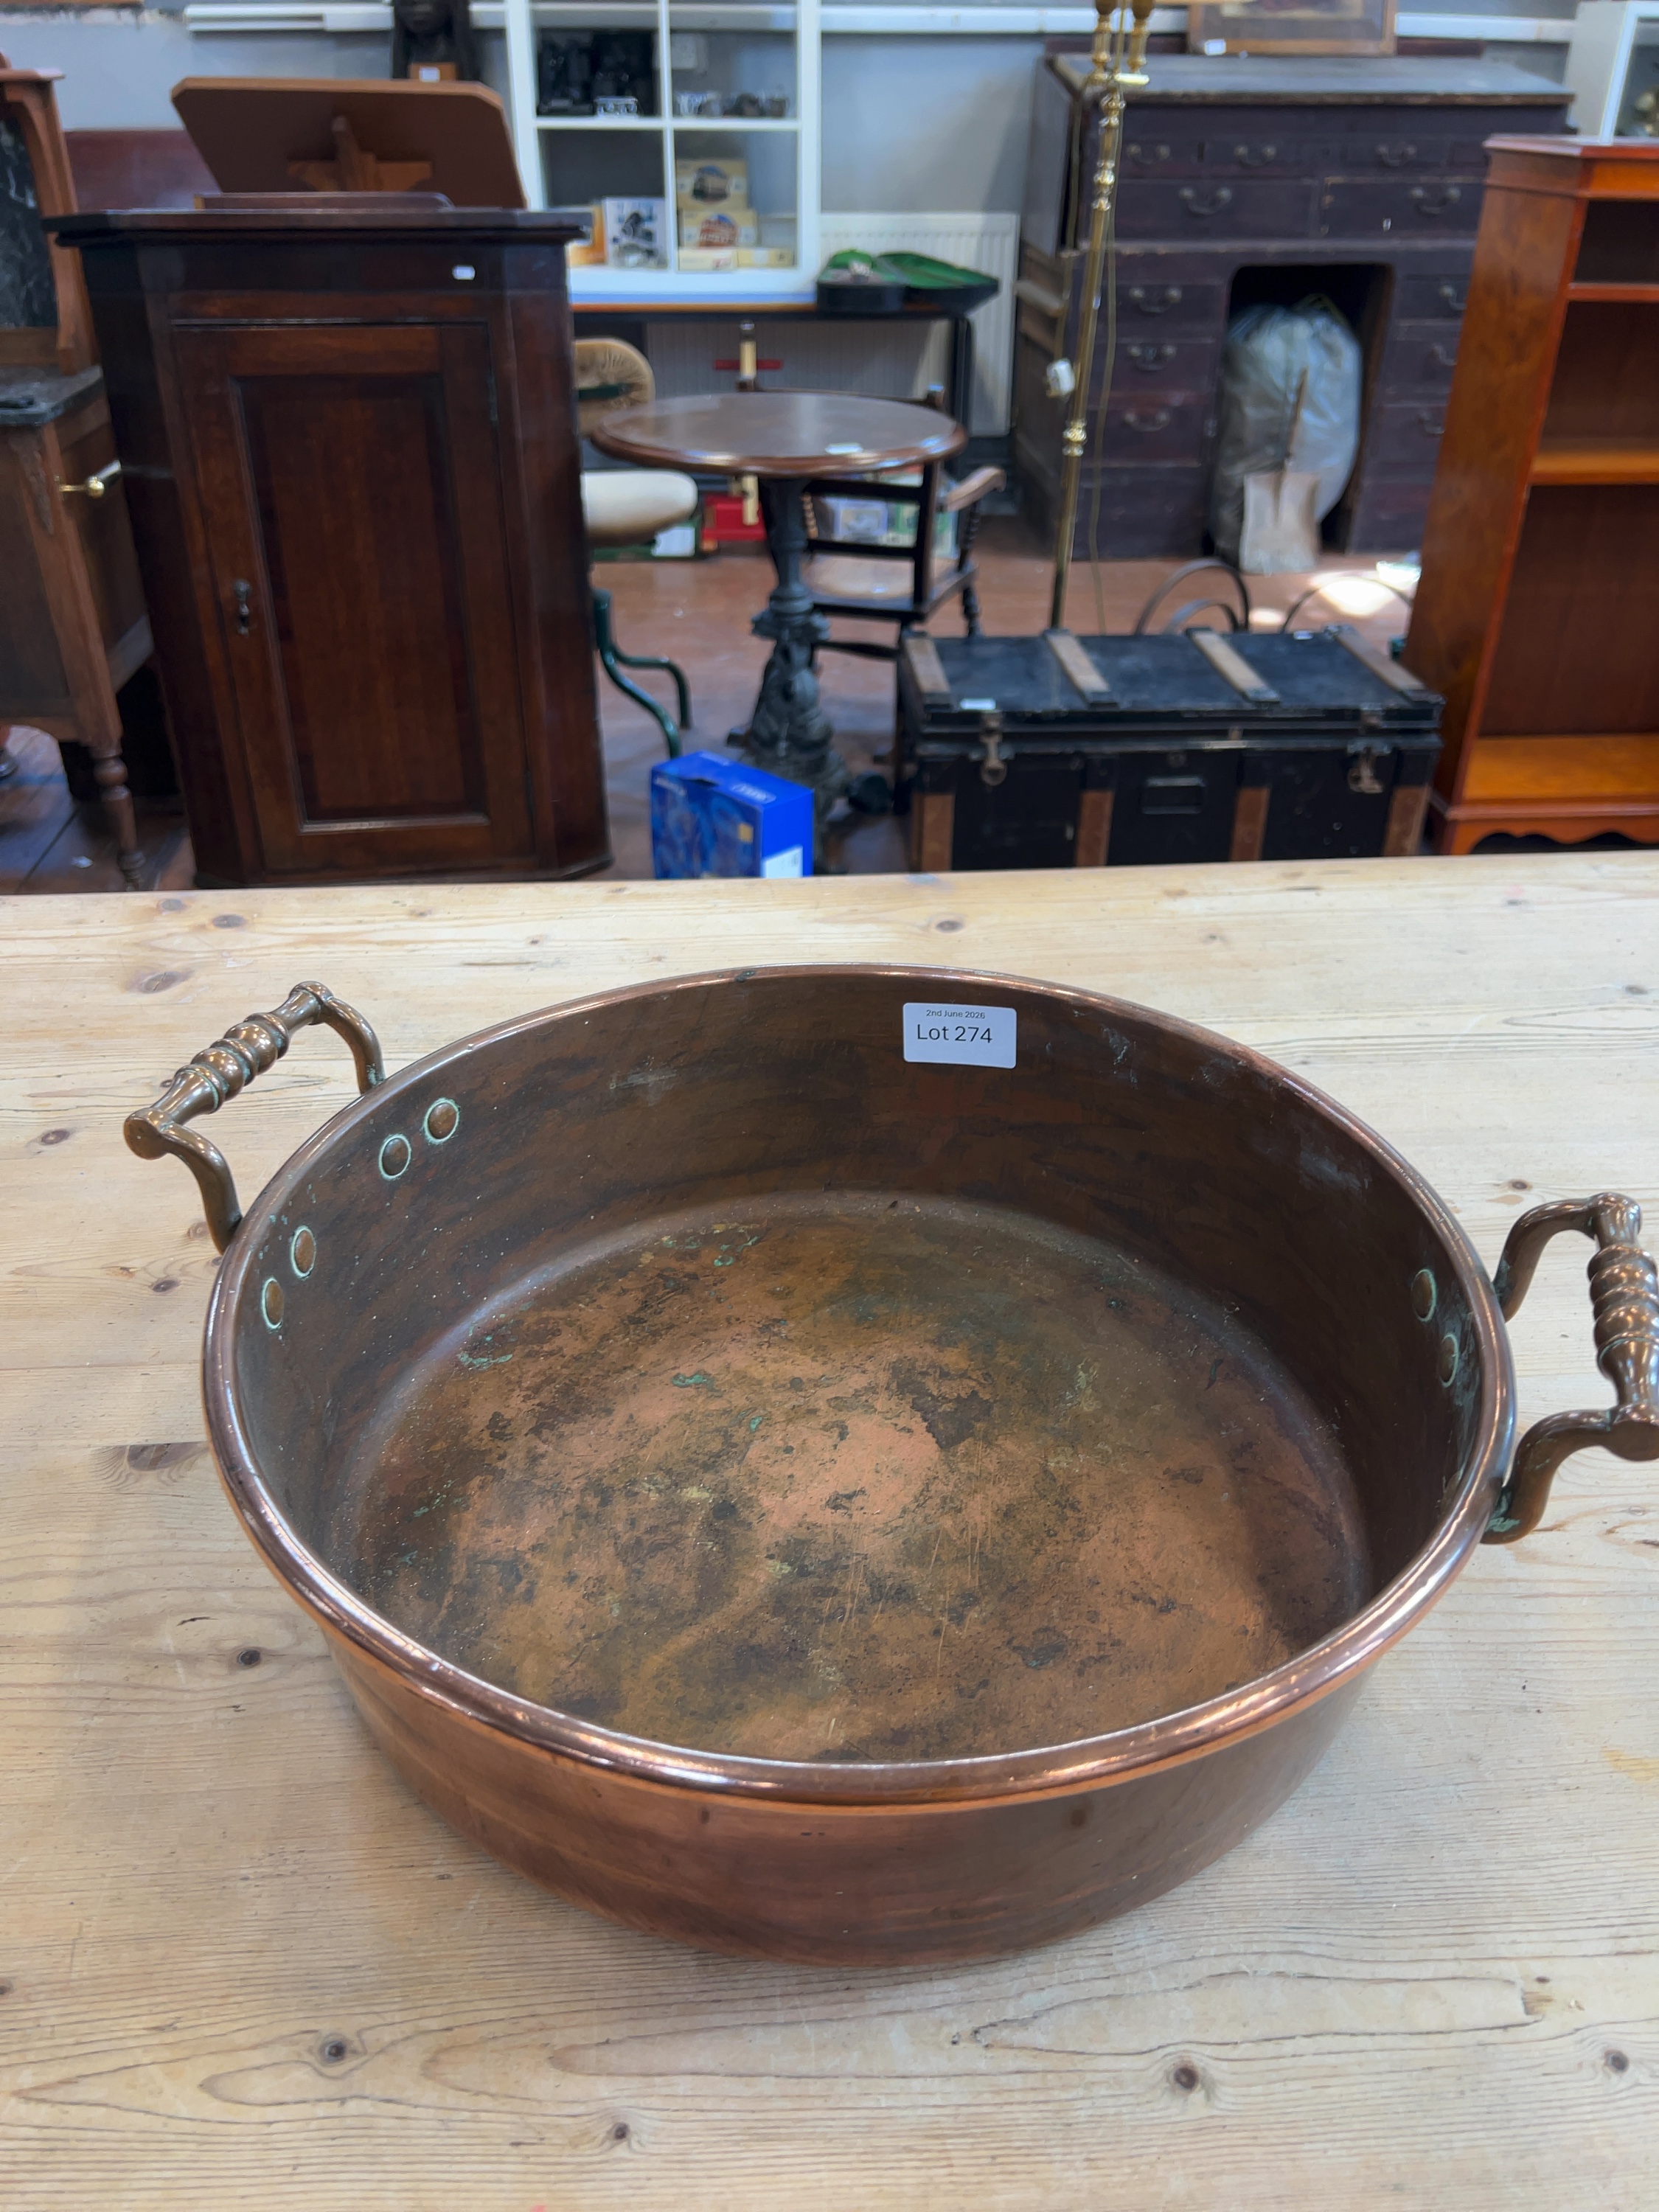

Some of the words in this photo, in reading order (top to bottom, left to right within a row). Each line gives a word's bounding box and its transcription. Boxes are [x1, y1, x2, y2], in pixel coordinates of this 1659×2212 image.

[964, 1011, 985, 1019] 2026
[917, 1024, 949, 1040] Lot
[955, 1026, 992, 1043] 274
